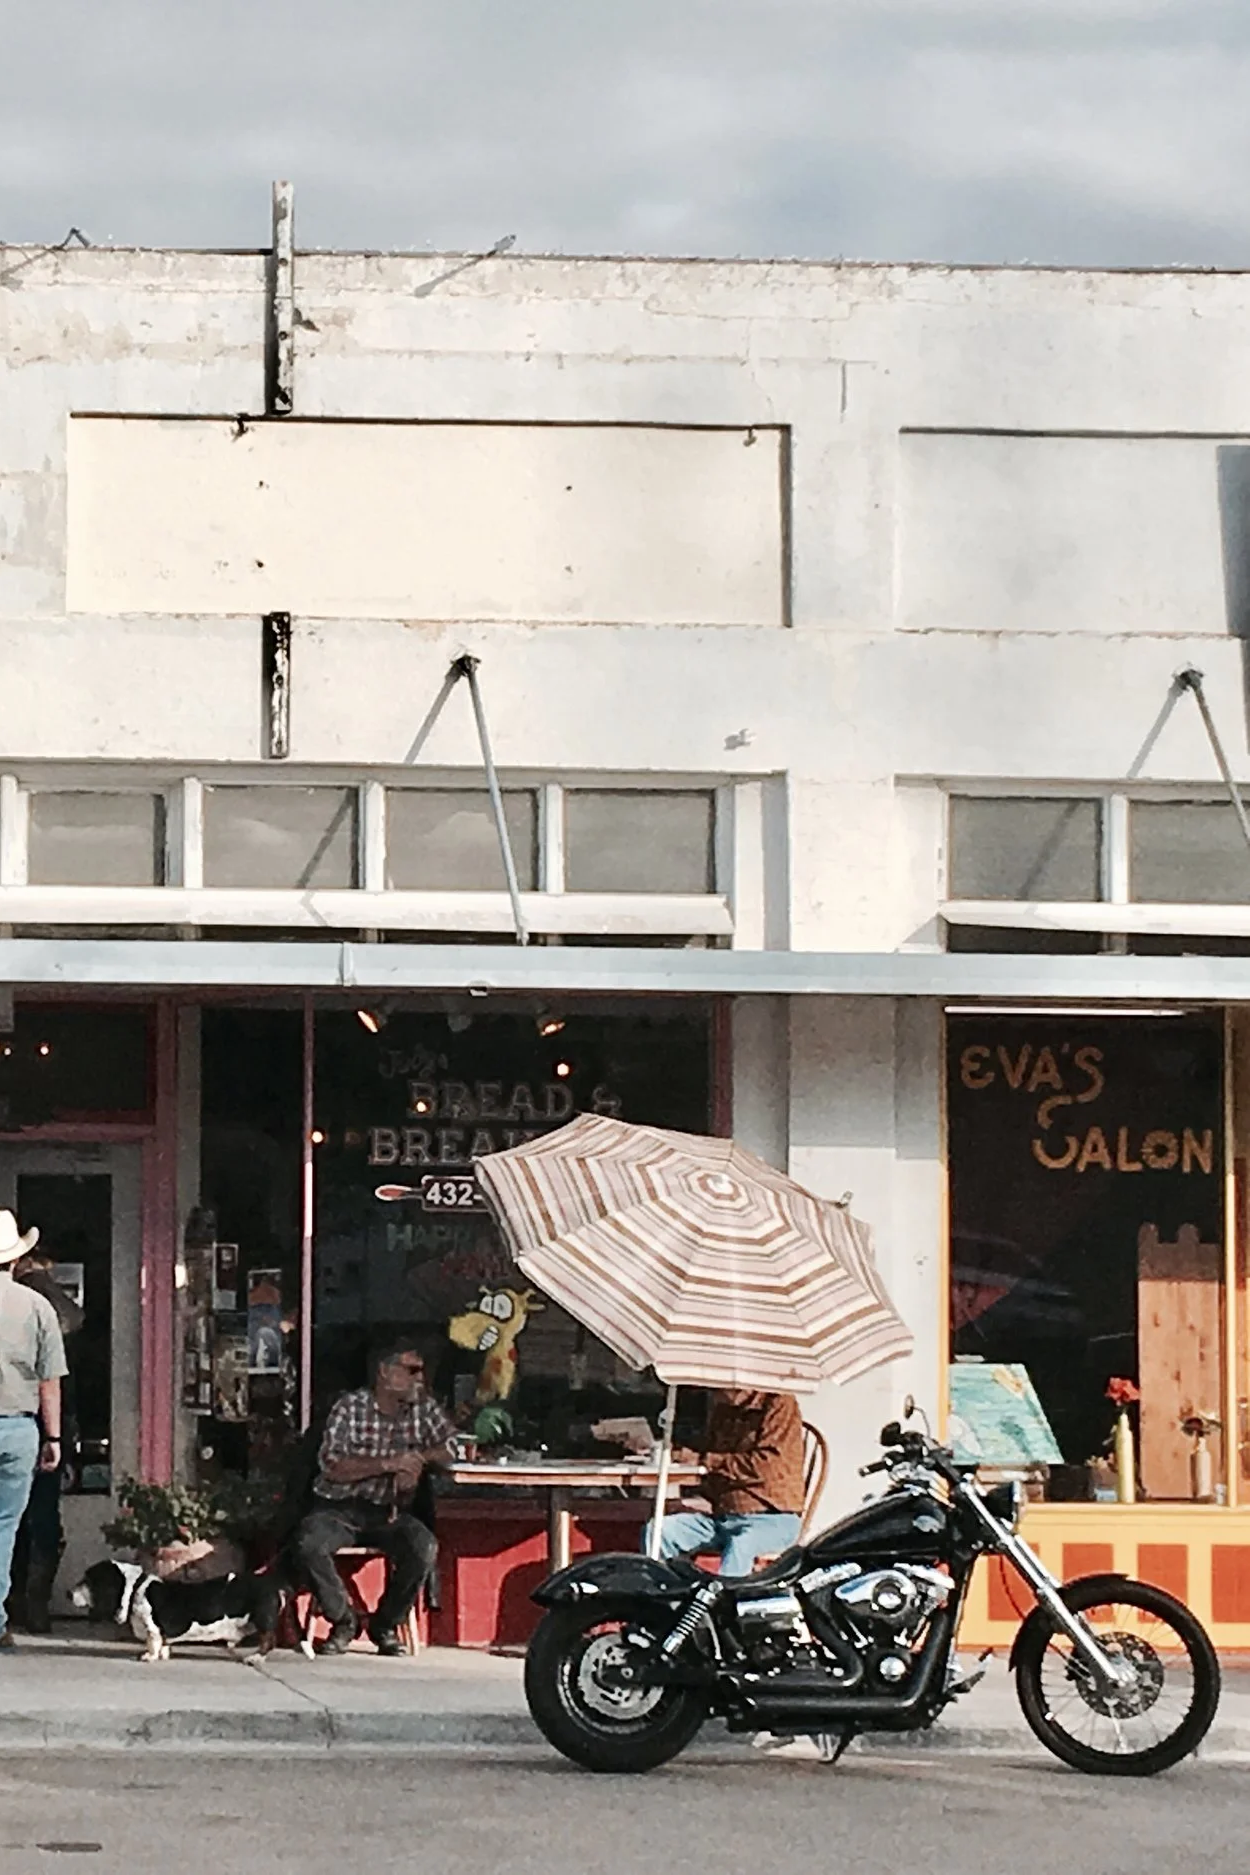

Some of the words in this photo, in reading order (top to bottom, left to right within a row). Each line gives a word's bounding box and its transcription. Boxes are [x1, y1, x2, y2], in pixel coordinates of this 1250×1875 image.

[406, 1080, 574, 1121] BREAD
[960, 1043, 1105, 1102] EVA'S
[1032, 1095, 1213, 1174] SALON
